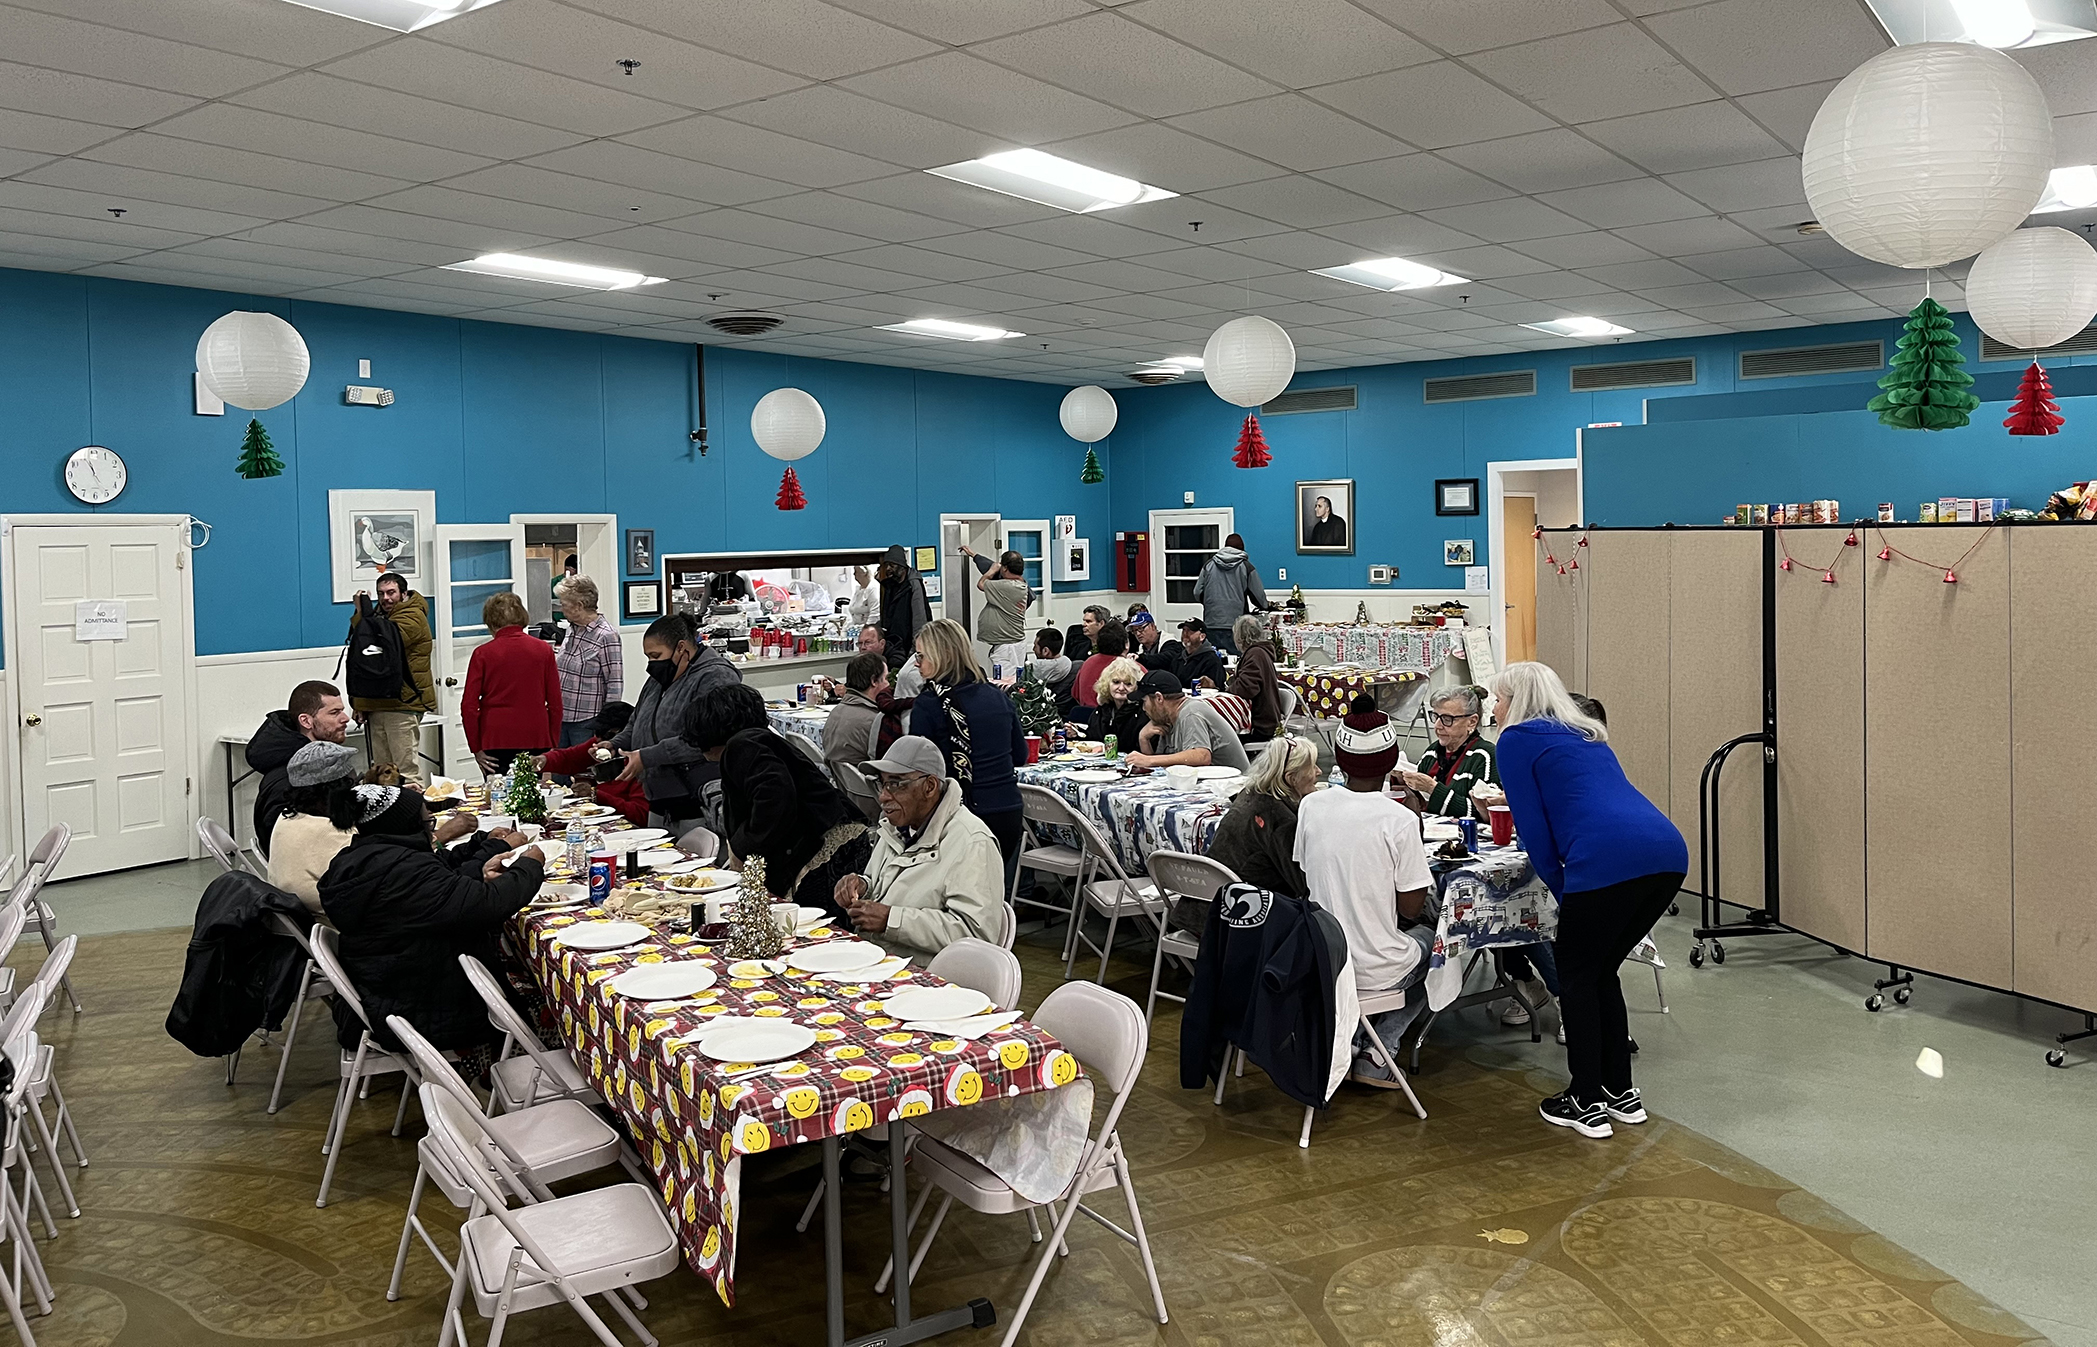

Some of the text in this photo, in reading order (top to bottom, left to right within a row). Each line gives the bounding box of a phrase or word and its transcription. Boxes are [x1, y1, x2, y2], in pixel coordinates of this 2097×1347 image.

[112, 460, 118, 469] 2
[67, 471, 73, 479] 9
[116, 471, 122, 479] 3
[71, 482, 78, 490] 8
[112, 481, 118, 489] 4
[81, 488, 86, 497] 7
[93, 491, 98, 500] 6
[104, 489, 110, 497] 5
